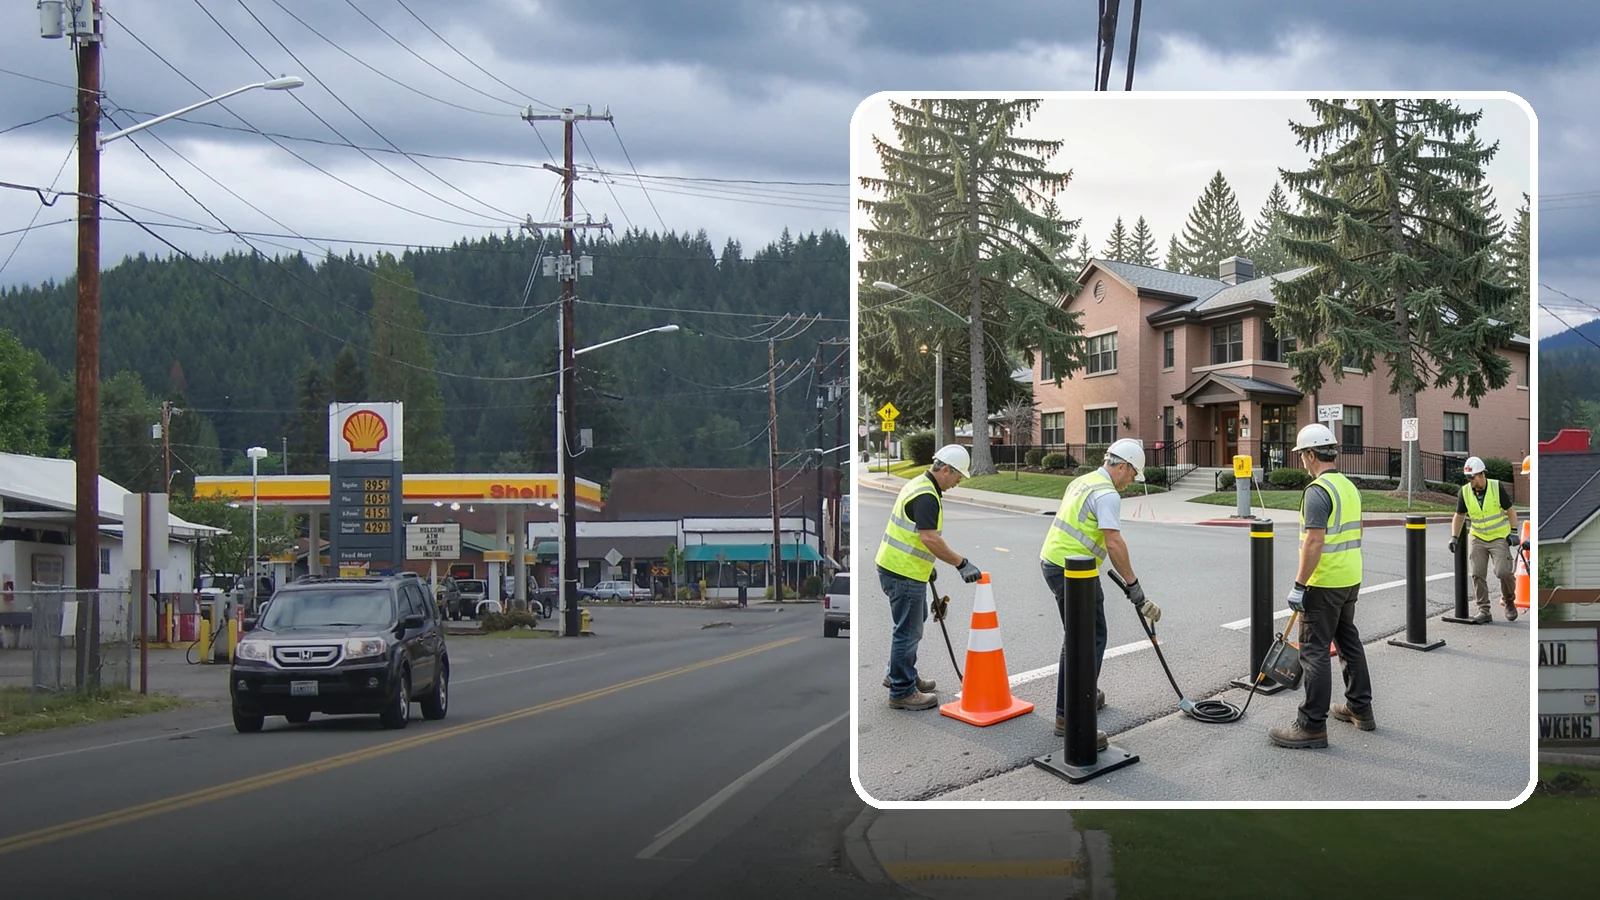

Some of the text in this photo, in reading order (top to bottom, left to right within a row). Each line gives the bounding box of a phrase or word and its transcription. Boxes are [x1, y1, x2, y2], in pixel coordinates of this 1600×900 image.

[365, 480, 384, 490] 395
[490, 484, 547, 499] Shell
[365, 494, 384, 504] 405
[365, 508, 384, 518] 415
[365, 522, 384, 532] 429
